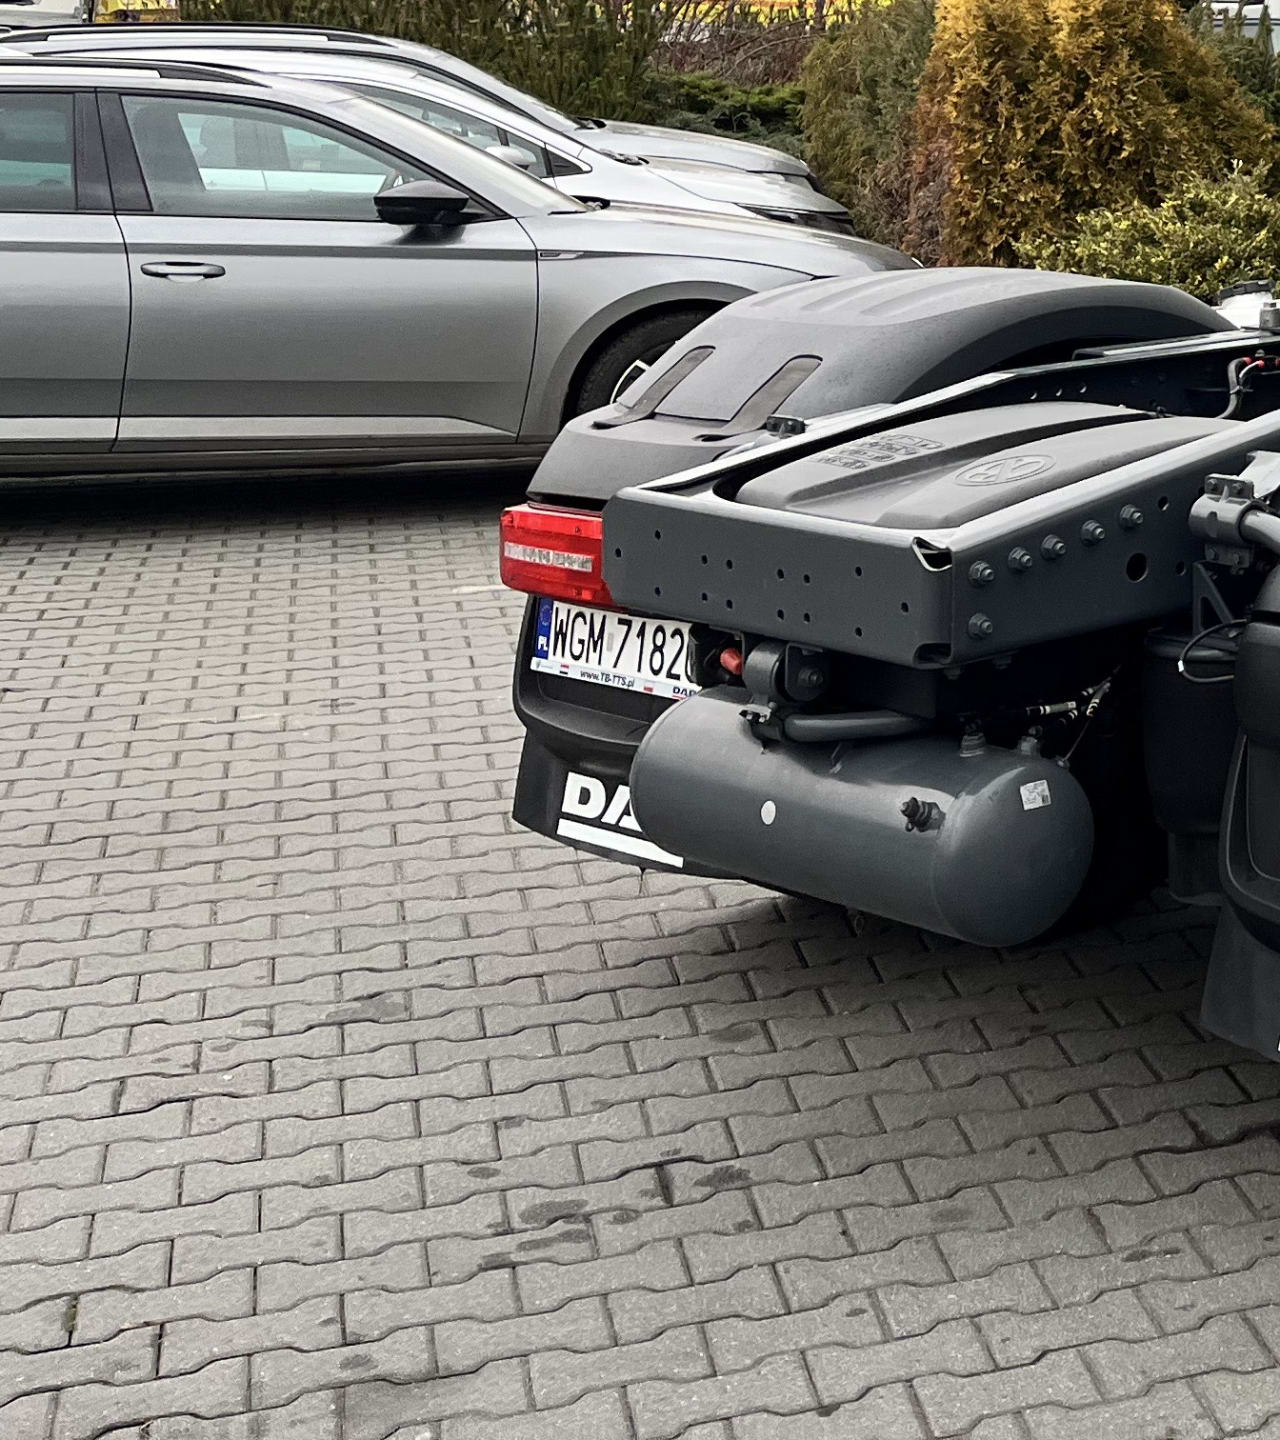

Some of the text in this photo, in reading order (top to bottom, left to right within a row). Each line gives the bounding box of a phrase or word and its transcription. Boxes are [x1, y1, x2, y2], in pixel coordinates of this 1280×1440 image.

[537, 635, 549, 652] PL
[552, 606, 607, 666] WGM
[562, 771, 643, 832] DA
